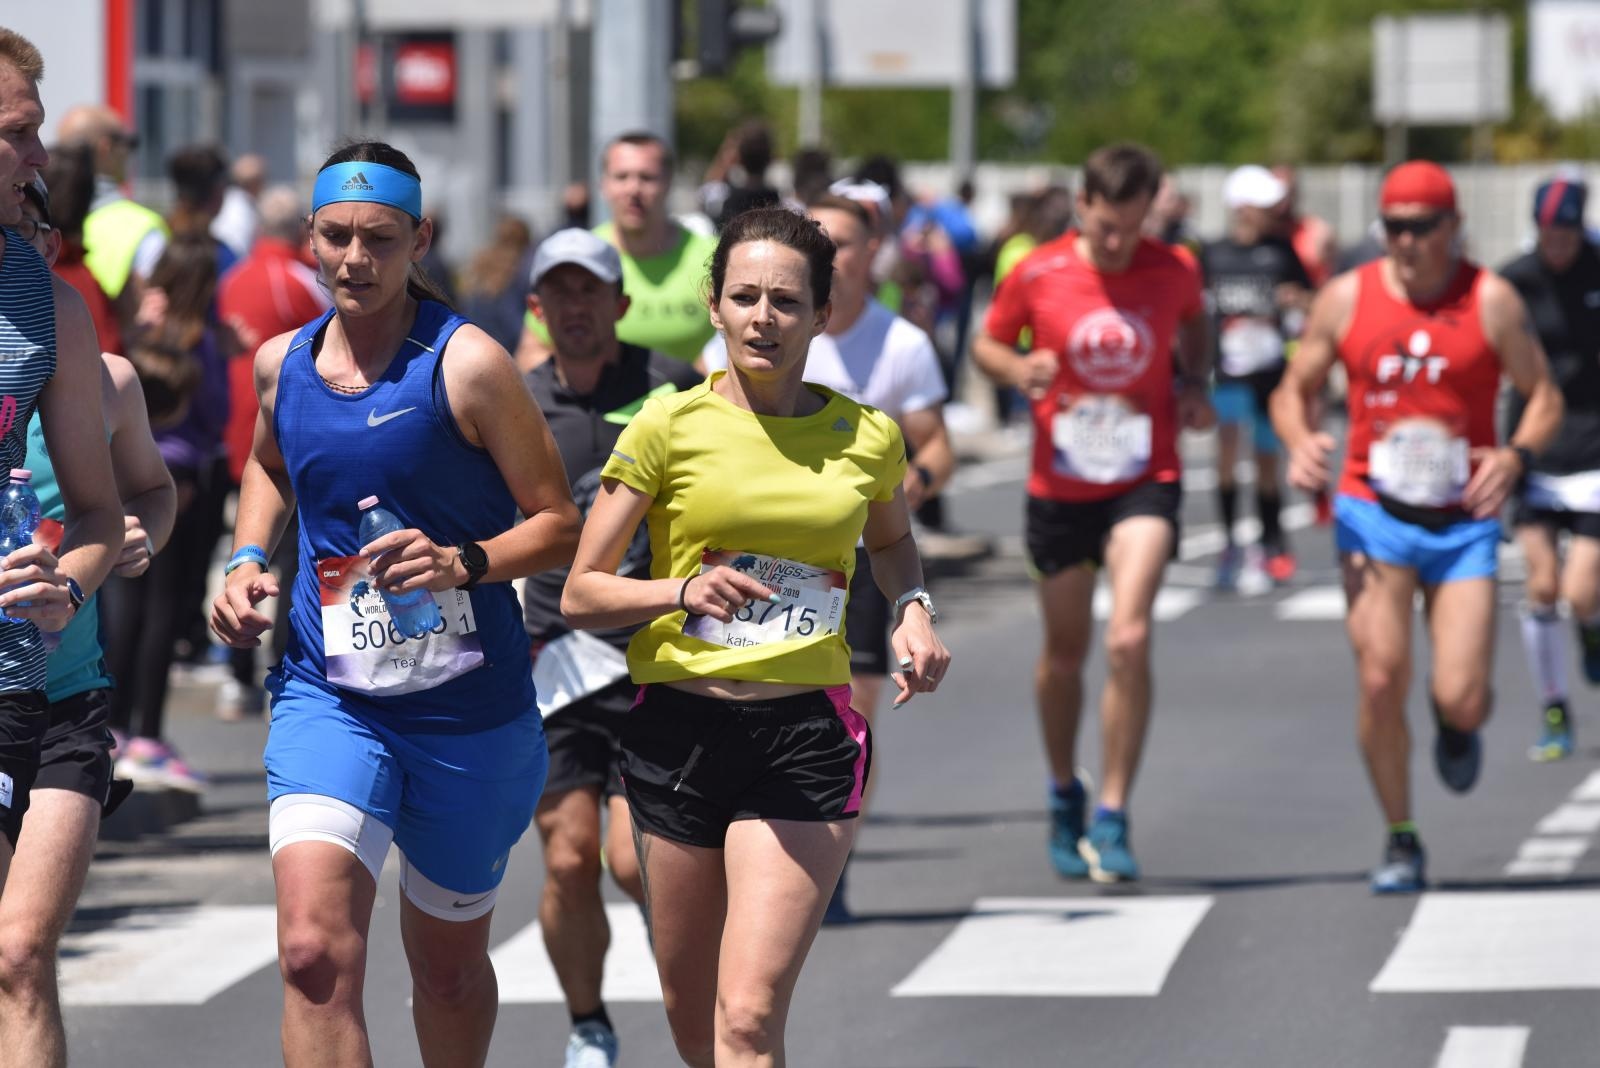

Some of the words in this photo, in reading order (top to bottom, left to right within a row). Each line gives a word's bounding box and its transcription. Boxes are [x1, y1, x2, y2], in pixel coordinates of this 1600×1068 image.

[342, 183, 374, 191] adidas
[760, 560, 803, 577] WINGS
[760, 571, 788, 584] LIFE
[783, 587, 800, 598] 2019
[829, 597, 840, 619] T1329
[352, 605, 447, 651] 5065
[459, 613, 470, 633] 1
[391, 657, 417, 669] Tea
